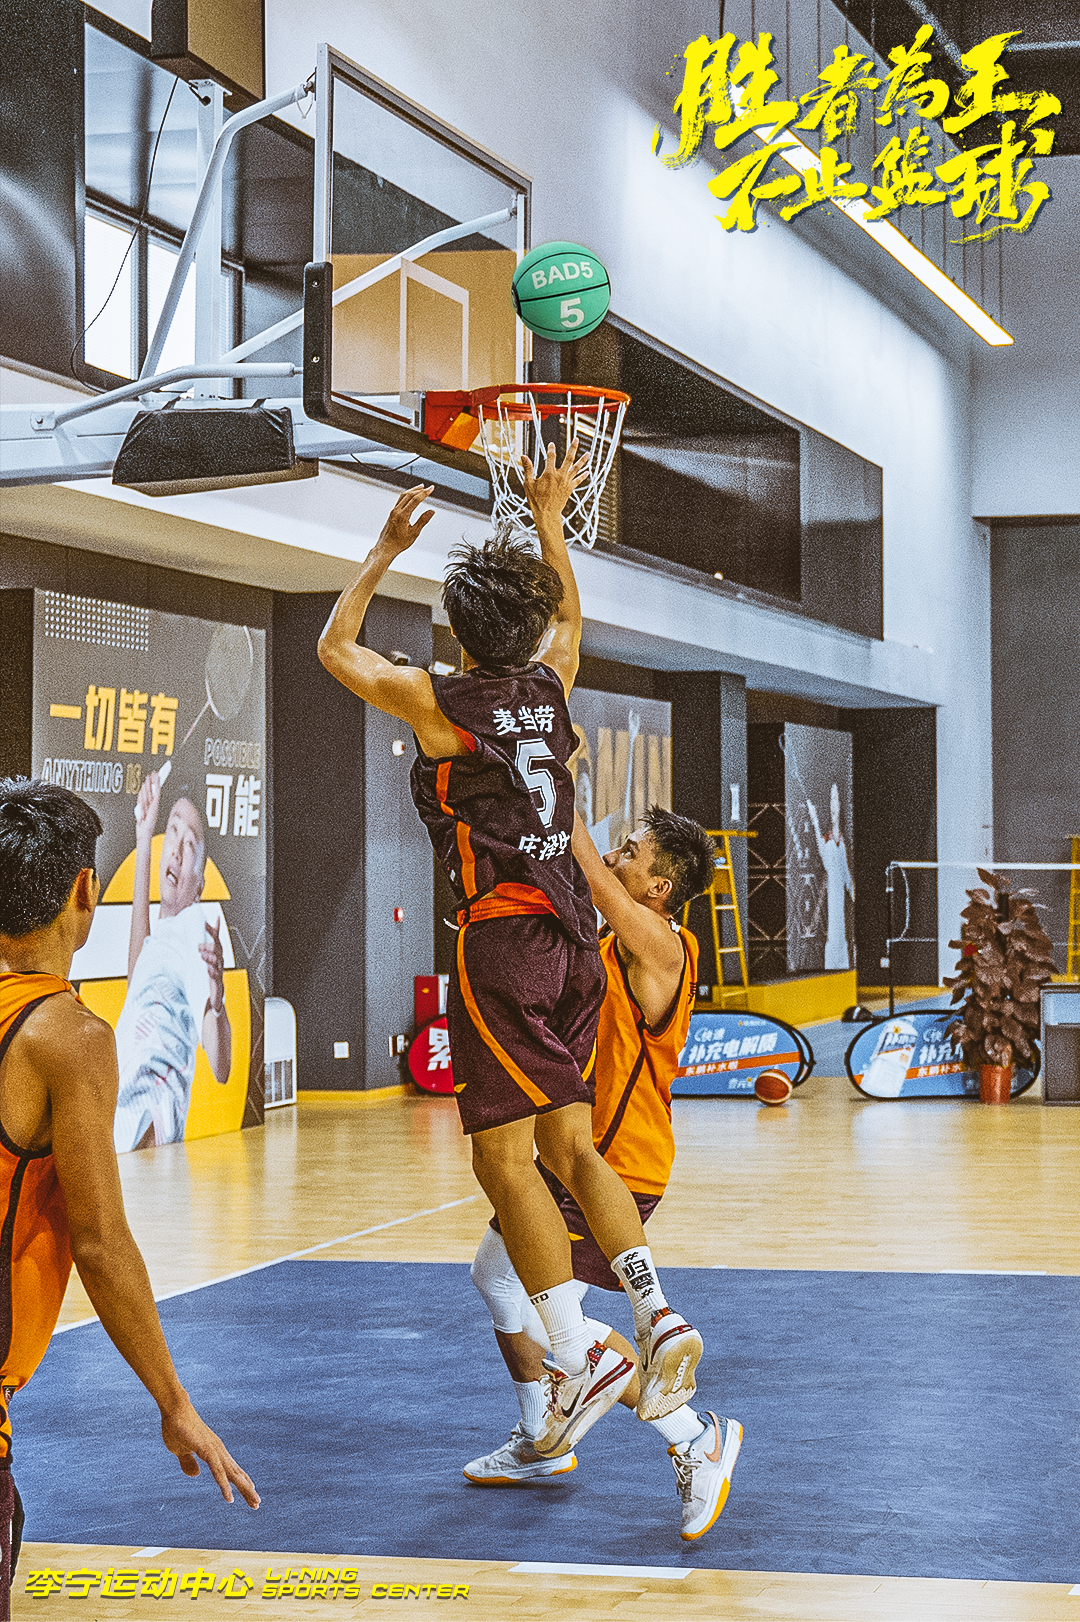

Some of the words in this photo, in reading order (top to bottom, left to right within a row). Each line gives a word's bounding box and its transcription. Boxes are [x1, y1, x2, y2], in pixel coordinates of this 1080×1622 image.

[532, 262, 594, 290] BAD5
[560, 297, 585, 329] 5
[50, 684, 178, 756] 一切皆有
[492, 704, 556, 736] 麦当劳
[204, 737, 262, 770] POSSIBLE
[41, 758, 123, 794] ANYTHING
[125, 762, 142, 796] IS
[514, 738, 556, 829] 5
[205, 773, 262, 837] 可能
[688, 1031, 778, 1064] 补充电解质
